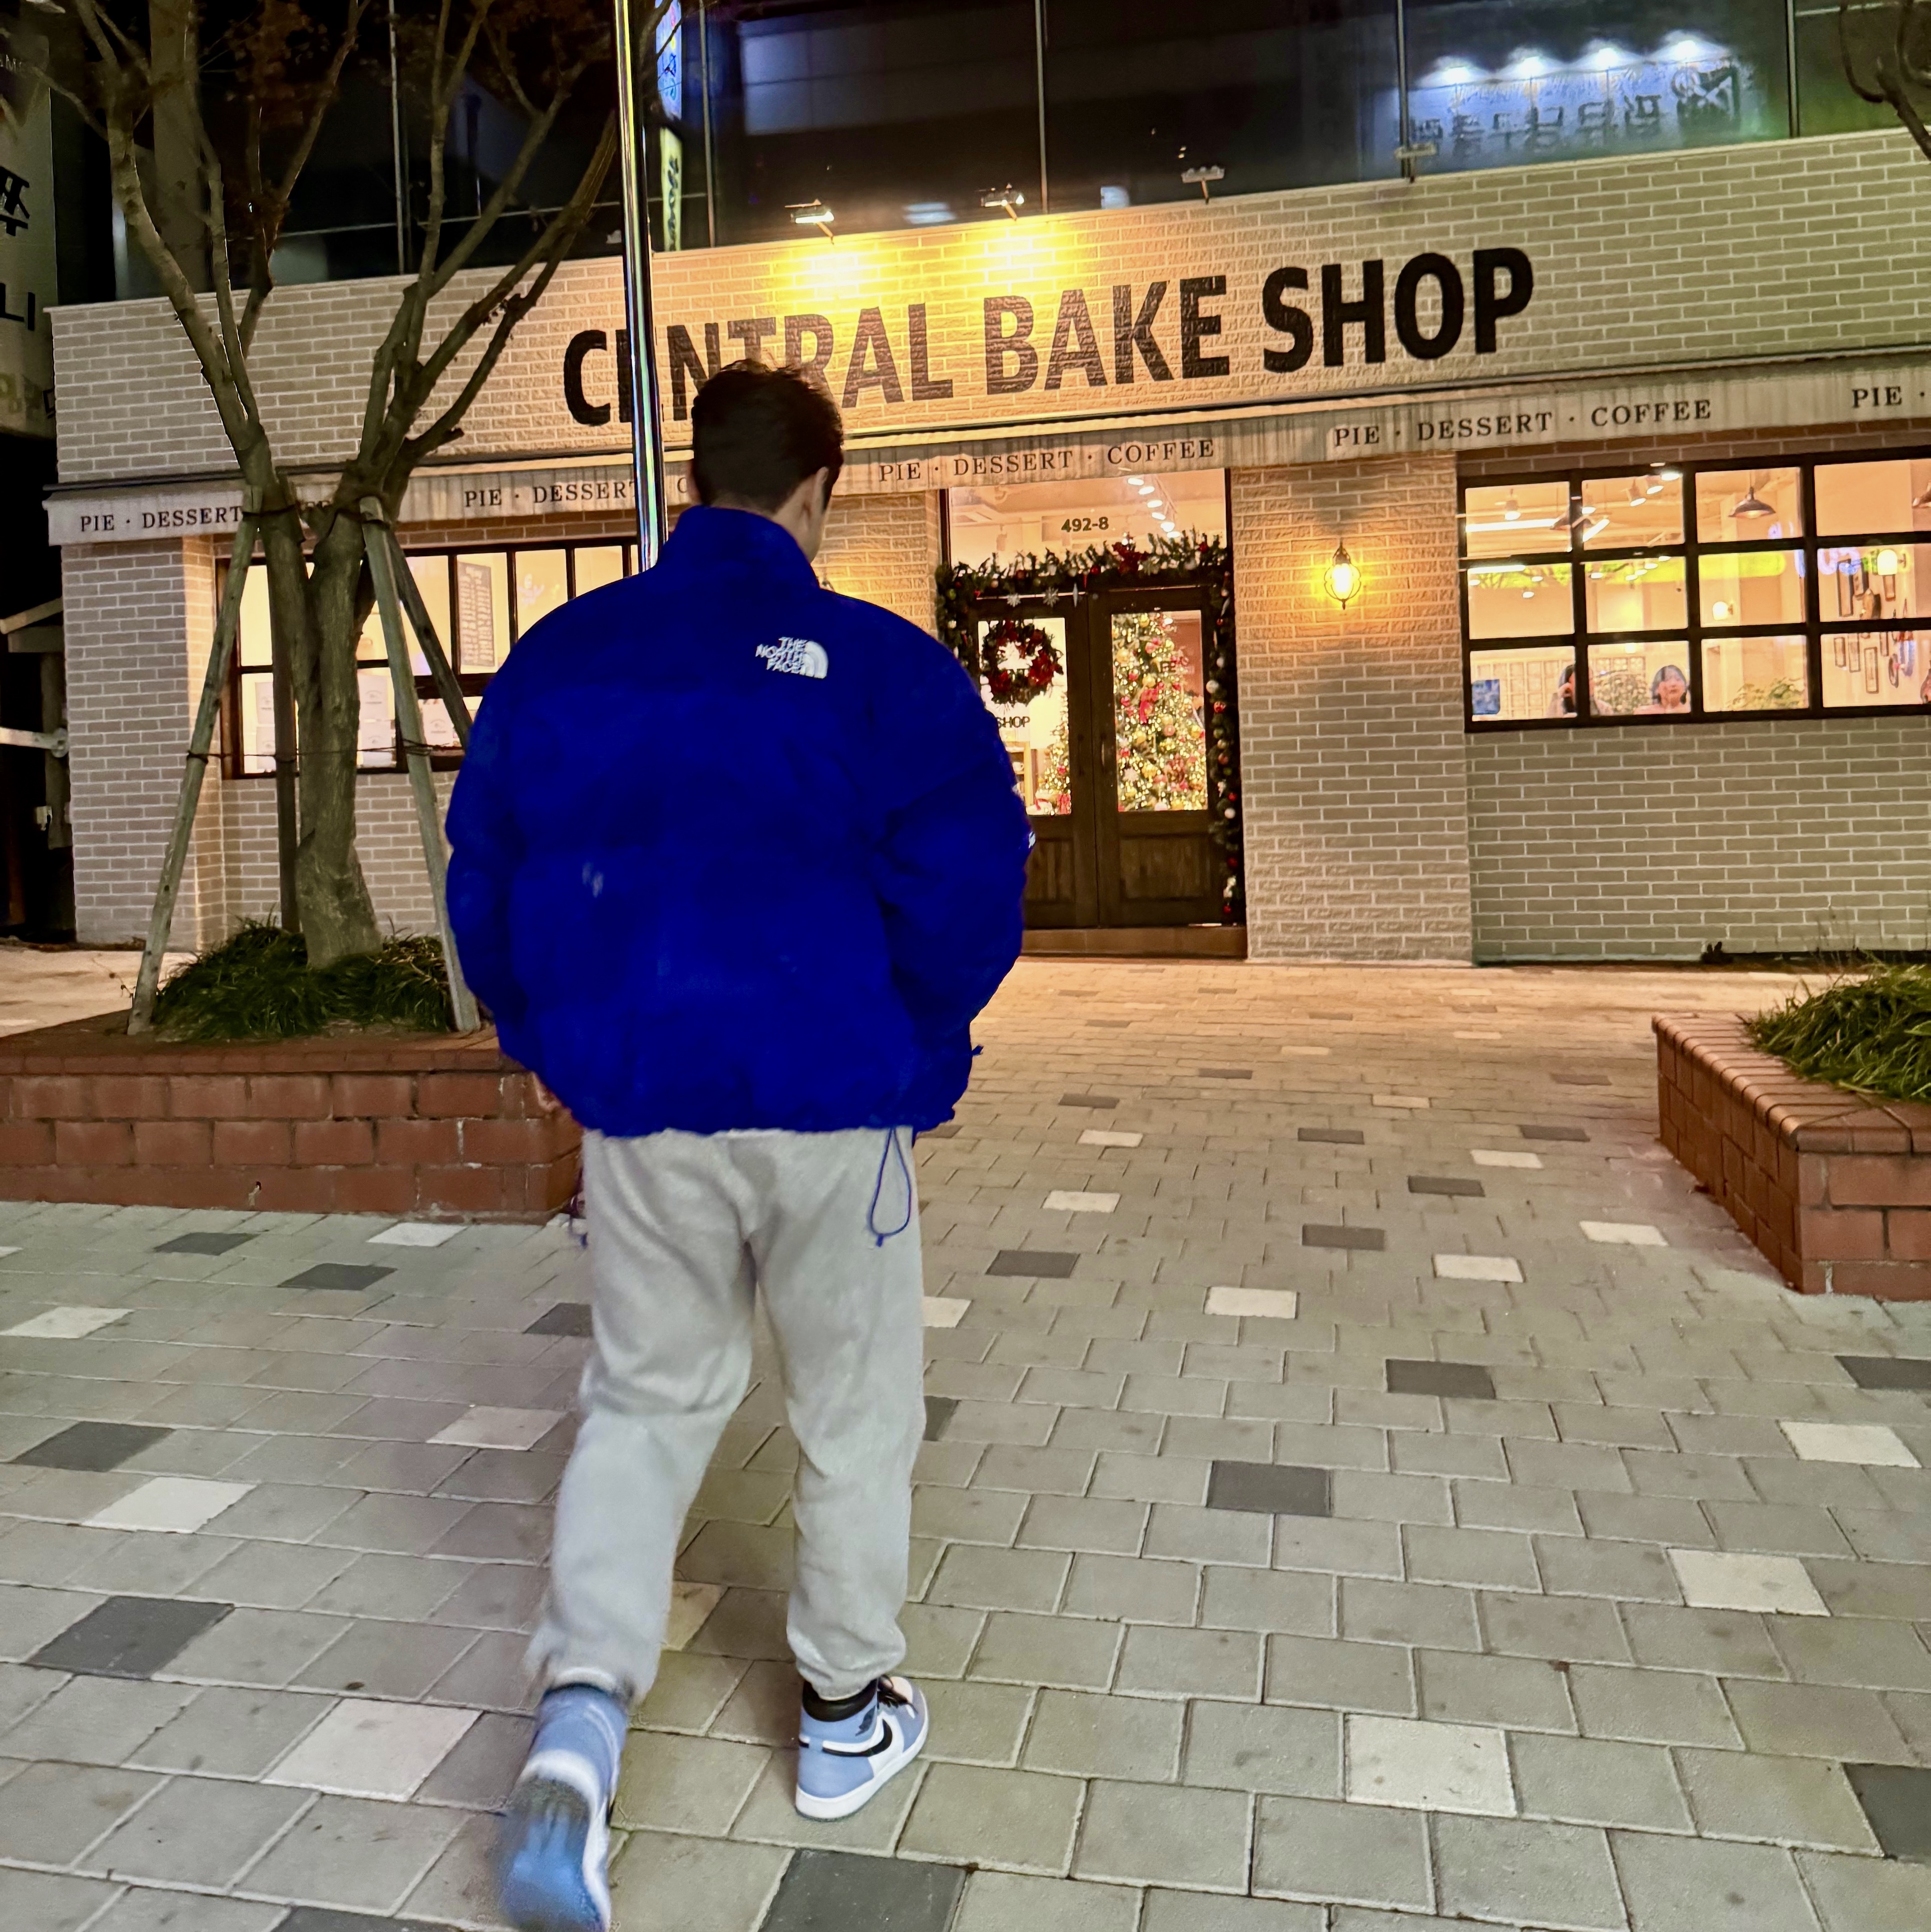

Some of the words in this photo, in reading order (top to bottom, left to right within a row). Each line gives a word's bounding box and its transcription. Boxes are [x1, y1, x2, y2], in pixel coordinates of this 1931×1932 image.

[983, 275, 1231, 395] BAKE
[1262, 248, 1533, 373] SHOP
[1852, 386, 1902, 408] PIE
[1334, 426, 1380, 446] PIE
[1417, 412, 1553, 441] DESSERT
[1591, 399, 1712, 427] COFFEE
[879, 463, 921, 482] PIE
[954, 450, 1073, 476] DESSERT
[1107, 440, 1214, 464] COFFEE
[465, 489, 502, 508] PIE
[80, 515, 114, 532] PIE
[142, 506, 242, 528] DESSERT
[1061, 517, 1109, 533] 492-8
[755, 644, 805, 663] NORTH
[779, 637, 807, 652] THE
[766, 657, 804, 674] FACE
